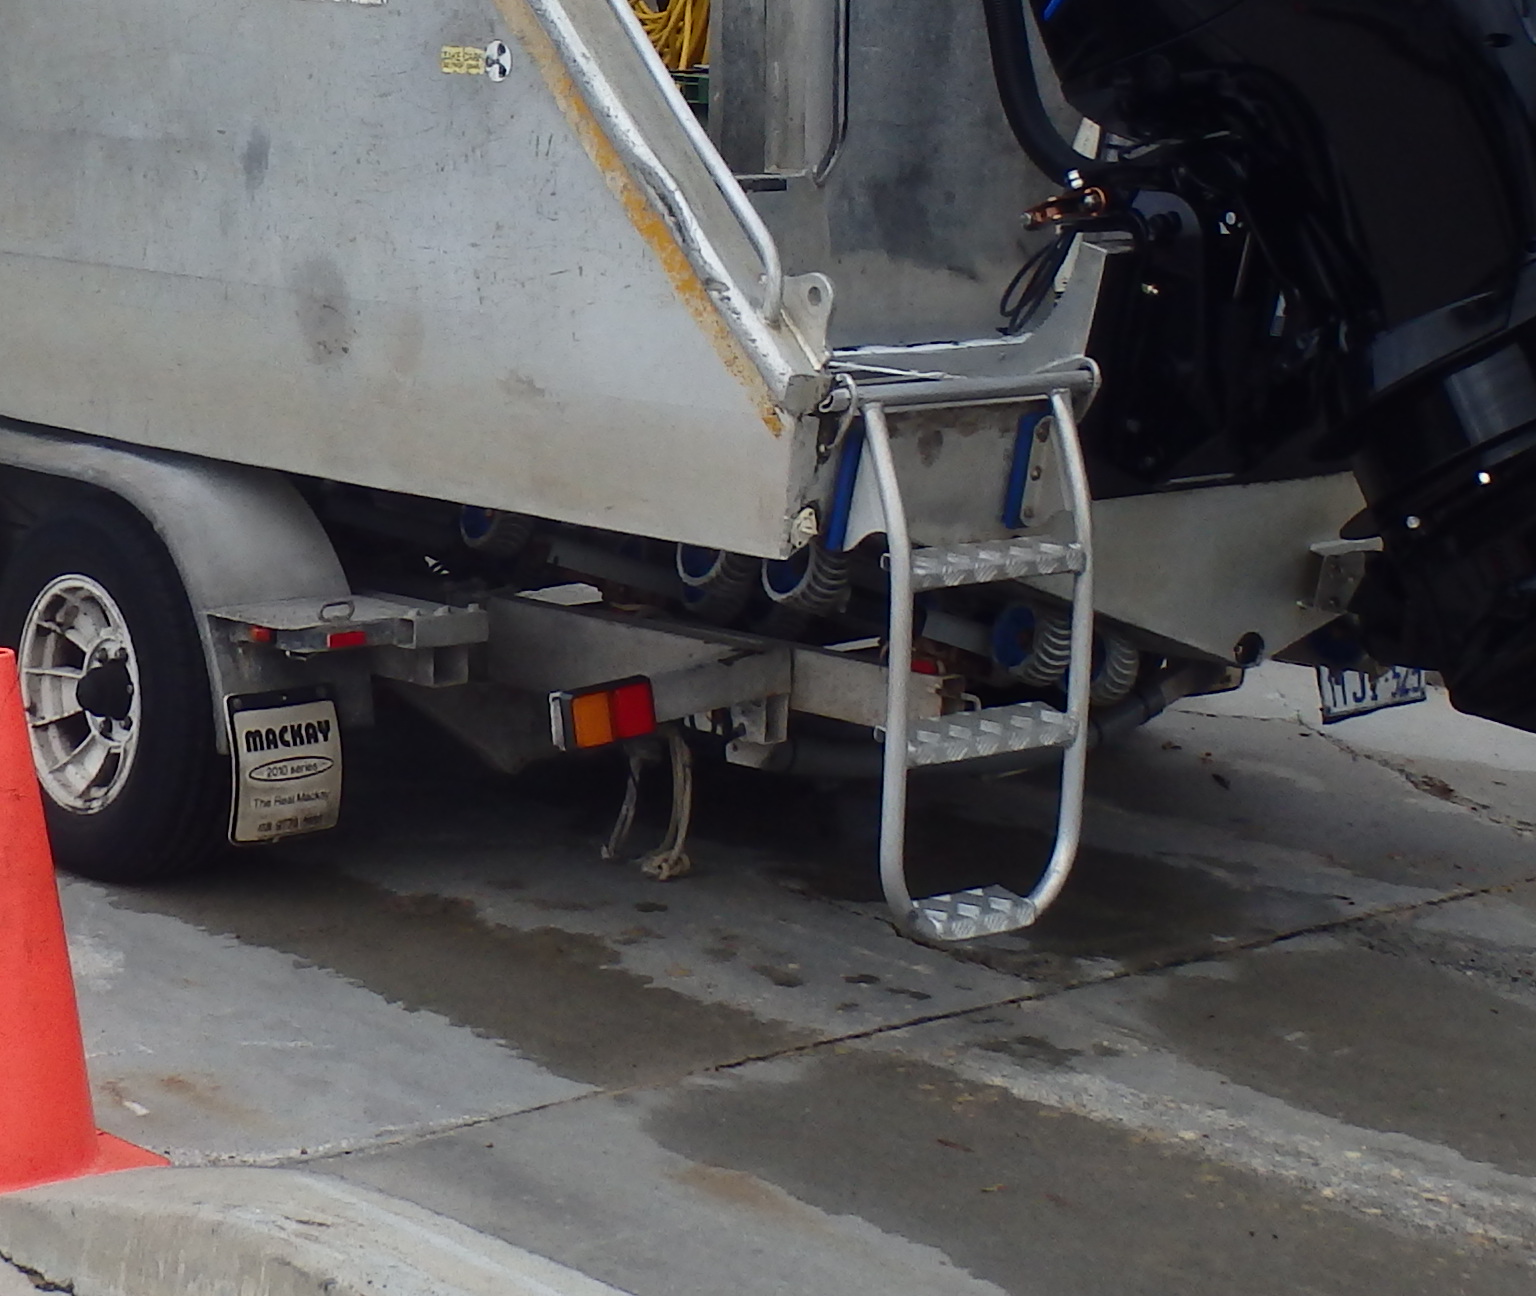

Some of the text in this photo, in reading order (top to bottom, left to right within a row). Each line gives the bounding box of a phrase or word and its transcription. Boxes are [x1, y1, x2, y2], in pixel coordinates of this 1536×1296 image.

[245, 719, 331, 752] MACKAY
[266, 762, 318, 778] 2010 series
[254, 798, 271, 808] The
